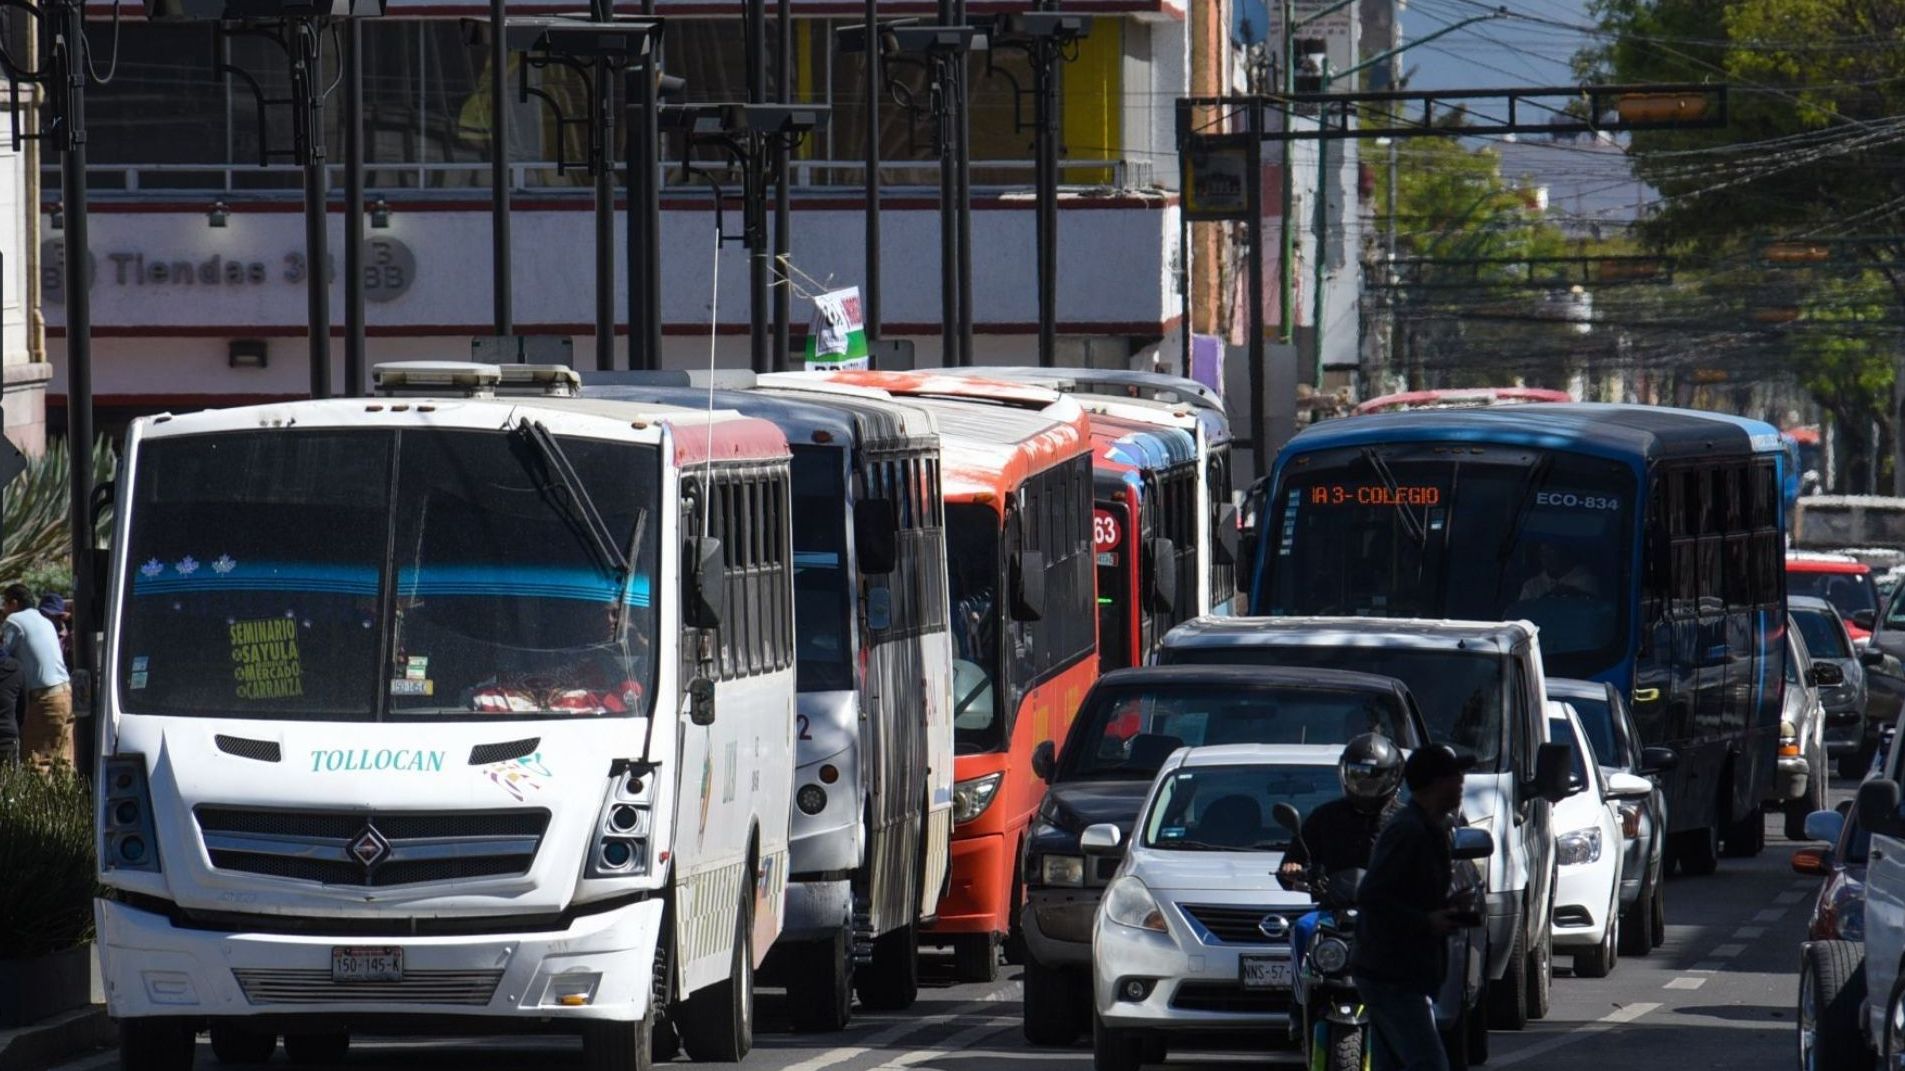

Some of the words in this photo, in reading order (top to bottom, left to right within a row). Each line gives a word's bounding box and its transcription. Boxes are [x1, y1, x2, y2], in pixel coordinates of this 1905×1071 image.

[371, 241, 393, 265] 3
[107, 252, 266, 285] Tiendas
[364, 266, 404, 290] BB
[1358, 486, 1439, 505] COLEGIO
[1536, 492, 1618, 510] ECO-834
[1094, 516, 1116, 544] 63
[230, 619, 295, 646] SEMINARIO
[242, 641, 299, 663] SAYULA
[245, 660, 300, 681] MERCADO
[246, 678, 303, 699] CARRANZA
[310, 749, 446, 772] TOLLOCAN
[338, 958, 399, 972] 150-145-K
[1244, 964, 1291, 980] NNS-57-
